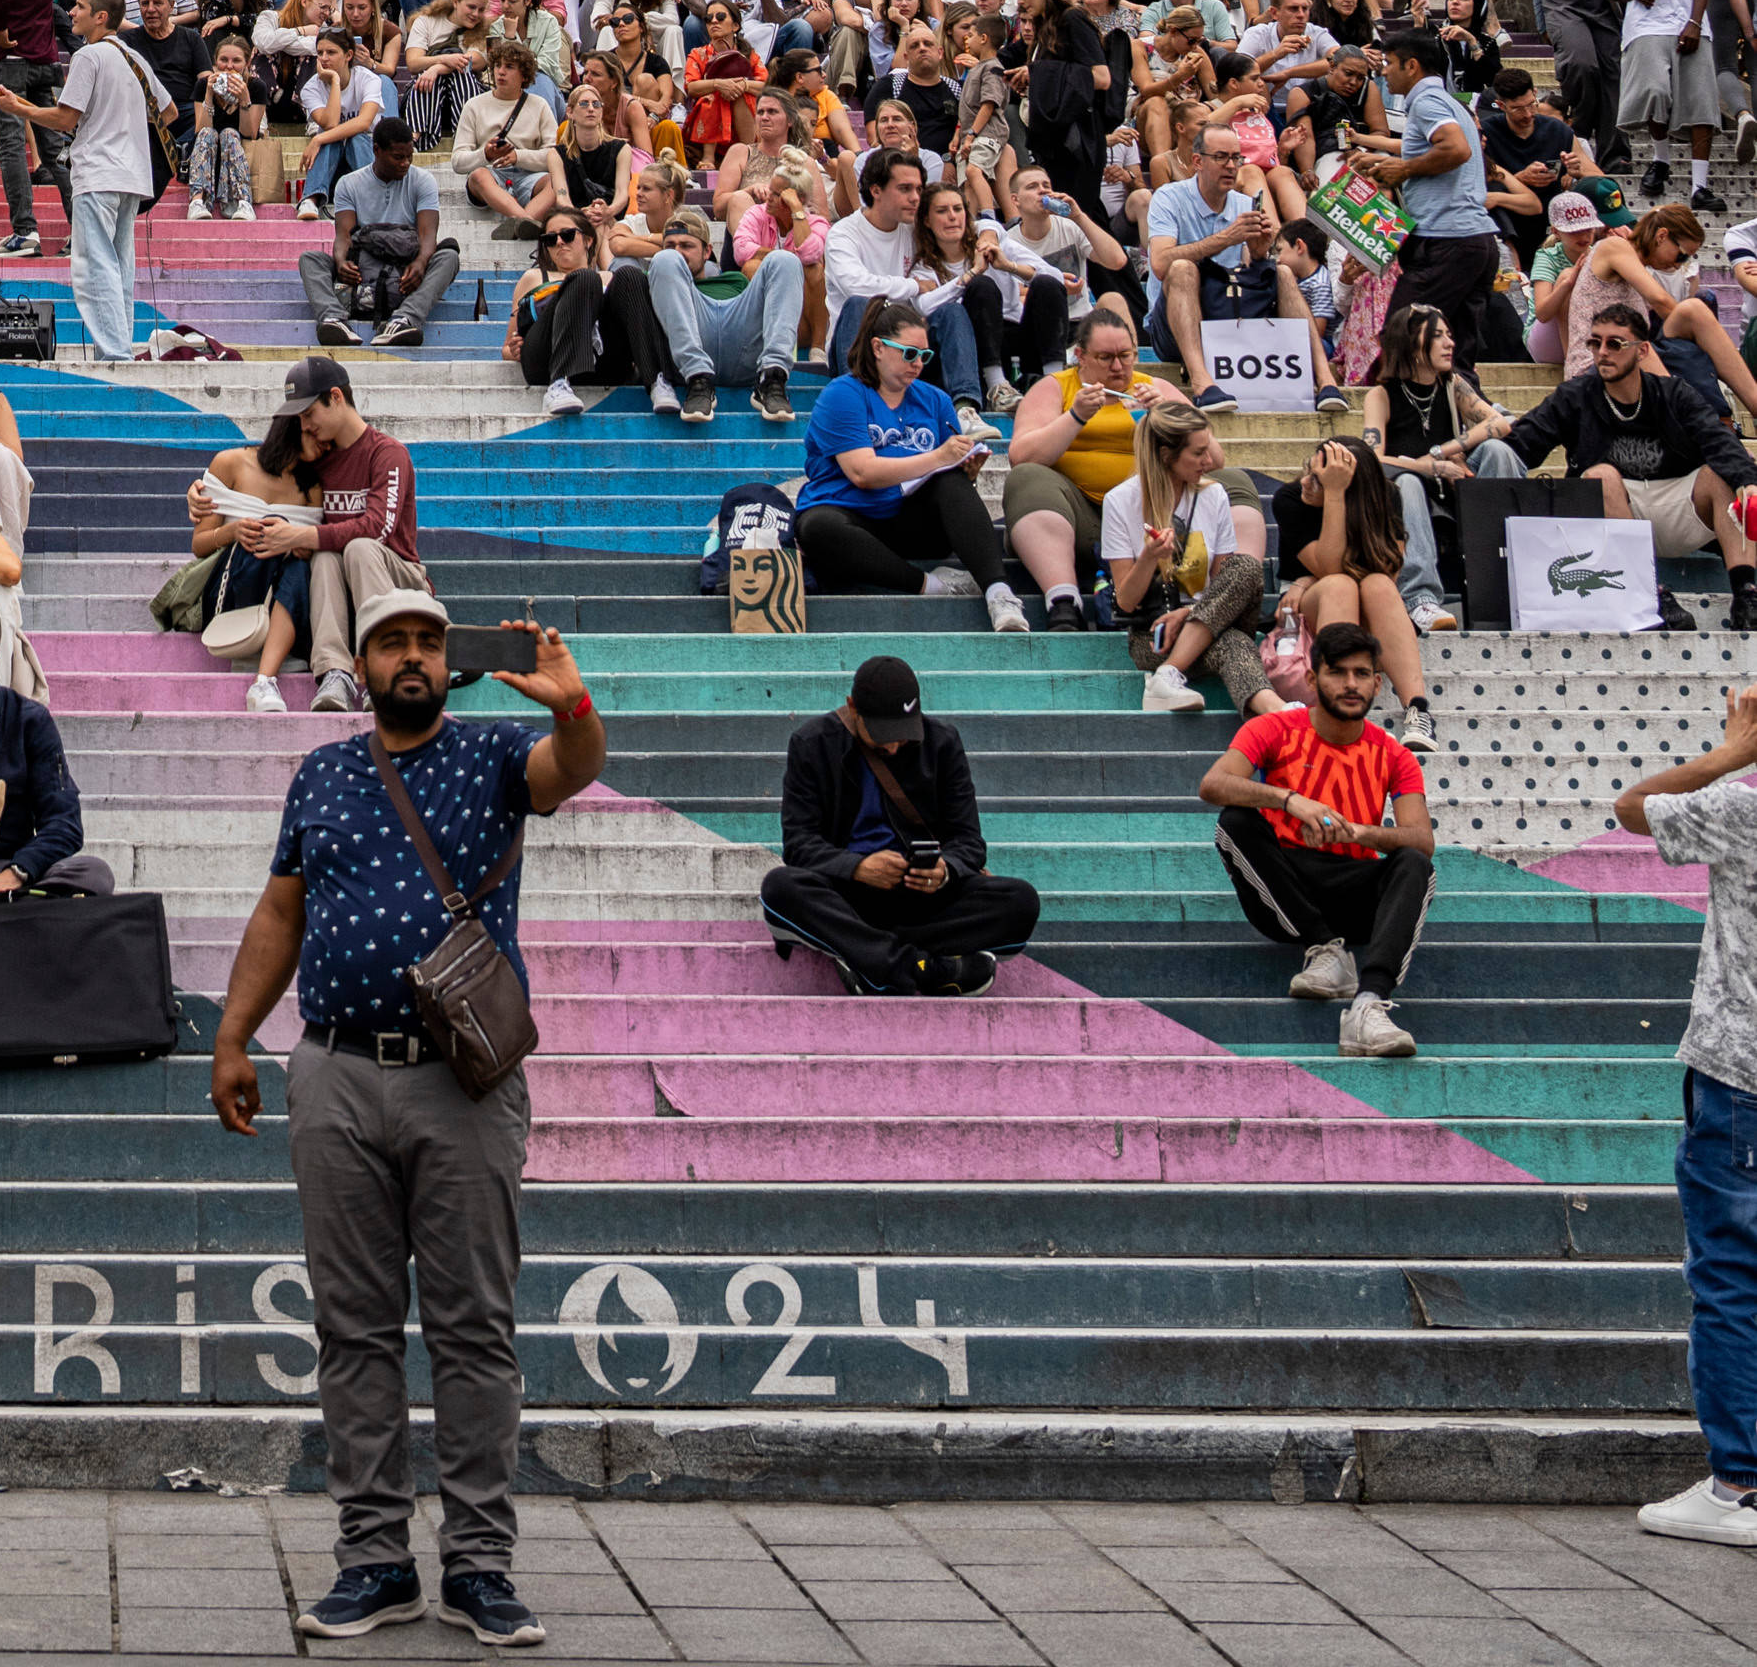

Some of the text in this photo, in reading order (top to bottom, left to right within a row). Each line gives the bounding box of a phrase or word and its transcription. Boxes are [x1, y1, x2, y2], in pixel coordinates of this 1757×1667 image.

[1565, 206, 1590, 221] COOL
[1214, 354, 1303, 380] BOSS
[387, 466, 400, 509] WALL
